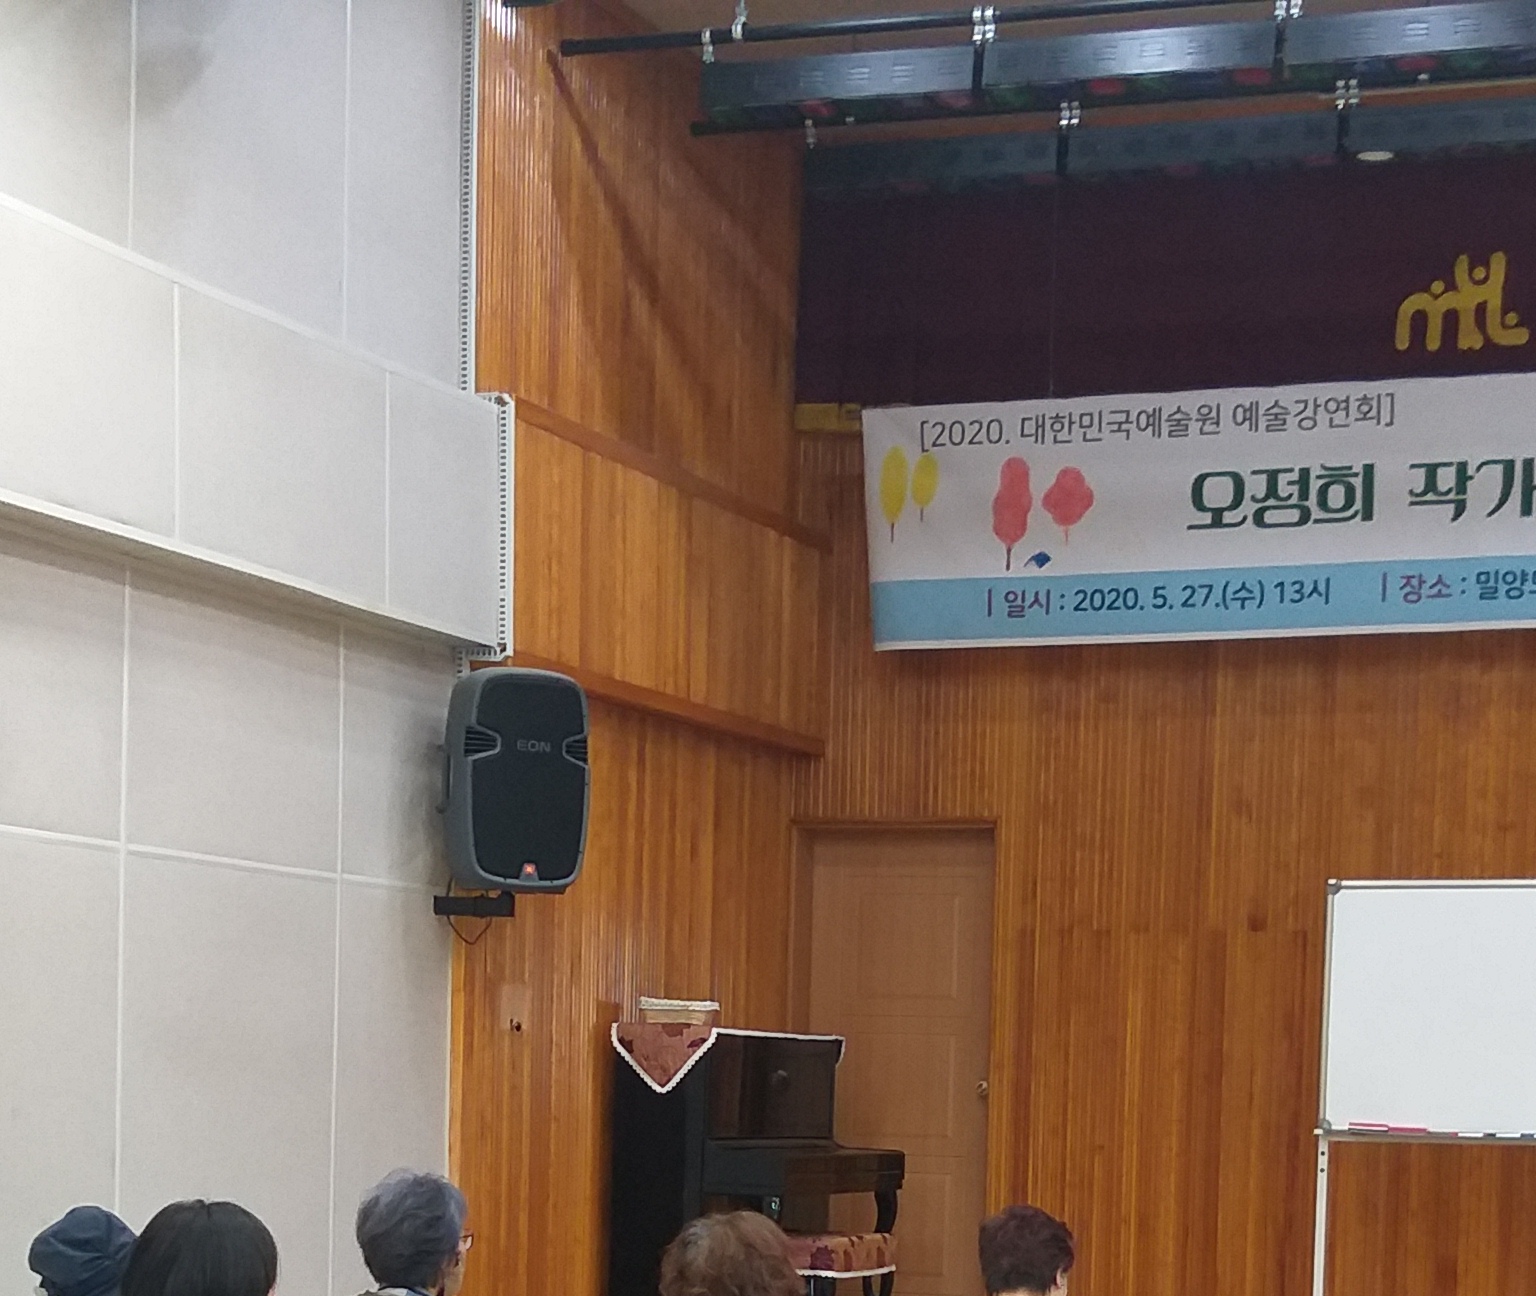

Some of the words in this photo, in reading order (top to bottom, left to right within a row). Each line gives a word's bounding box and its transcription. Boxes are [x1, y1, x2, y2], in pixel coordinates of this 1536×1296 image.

[920, 418, 1011, 453] [2020.
[1020, 403, 1222, 446] 대한민국예술원
[1231, 392, 1396, 434] 예술강연회]
[1186, 462, 1376, 531] 오정희
[1072, 587, 1146, 613] 2020.
[1273, 576, 1332, 607] 13시
[517, 739, 551, 753] EON
